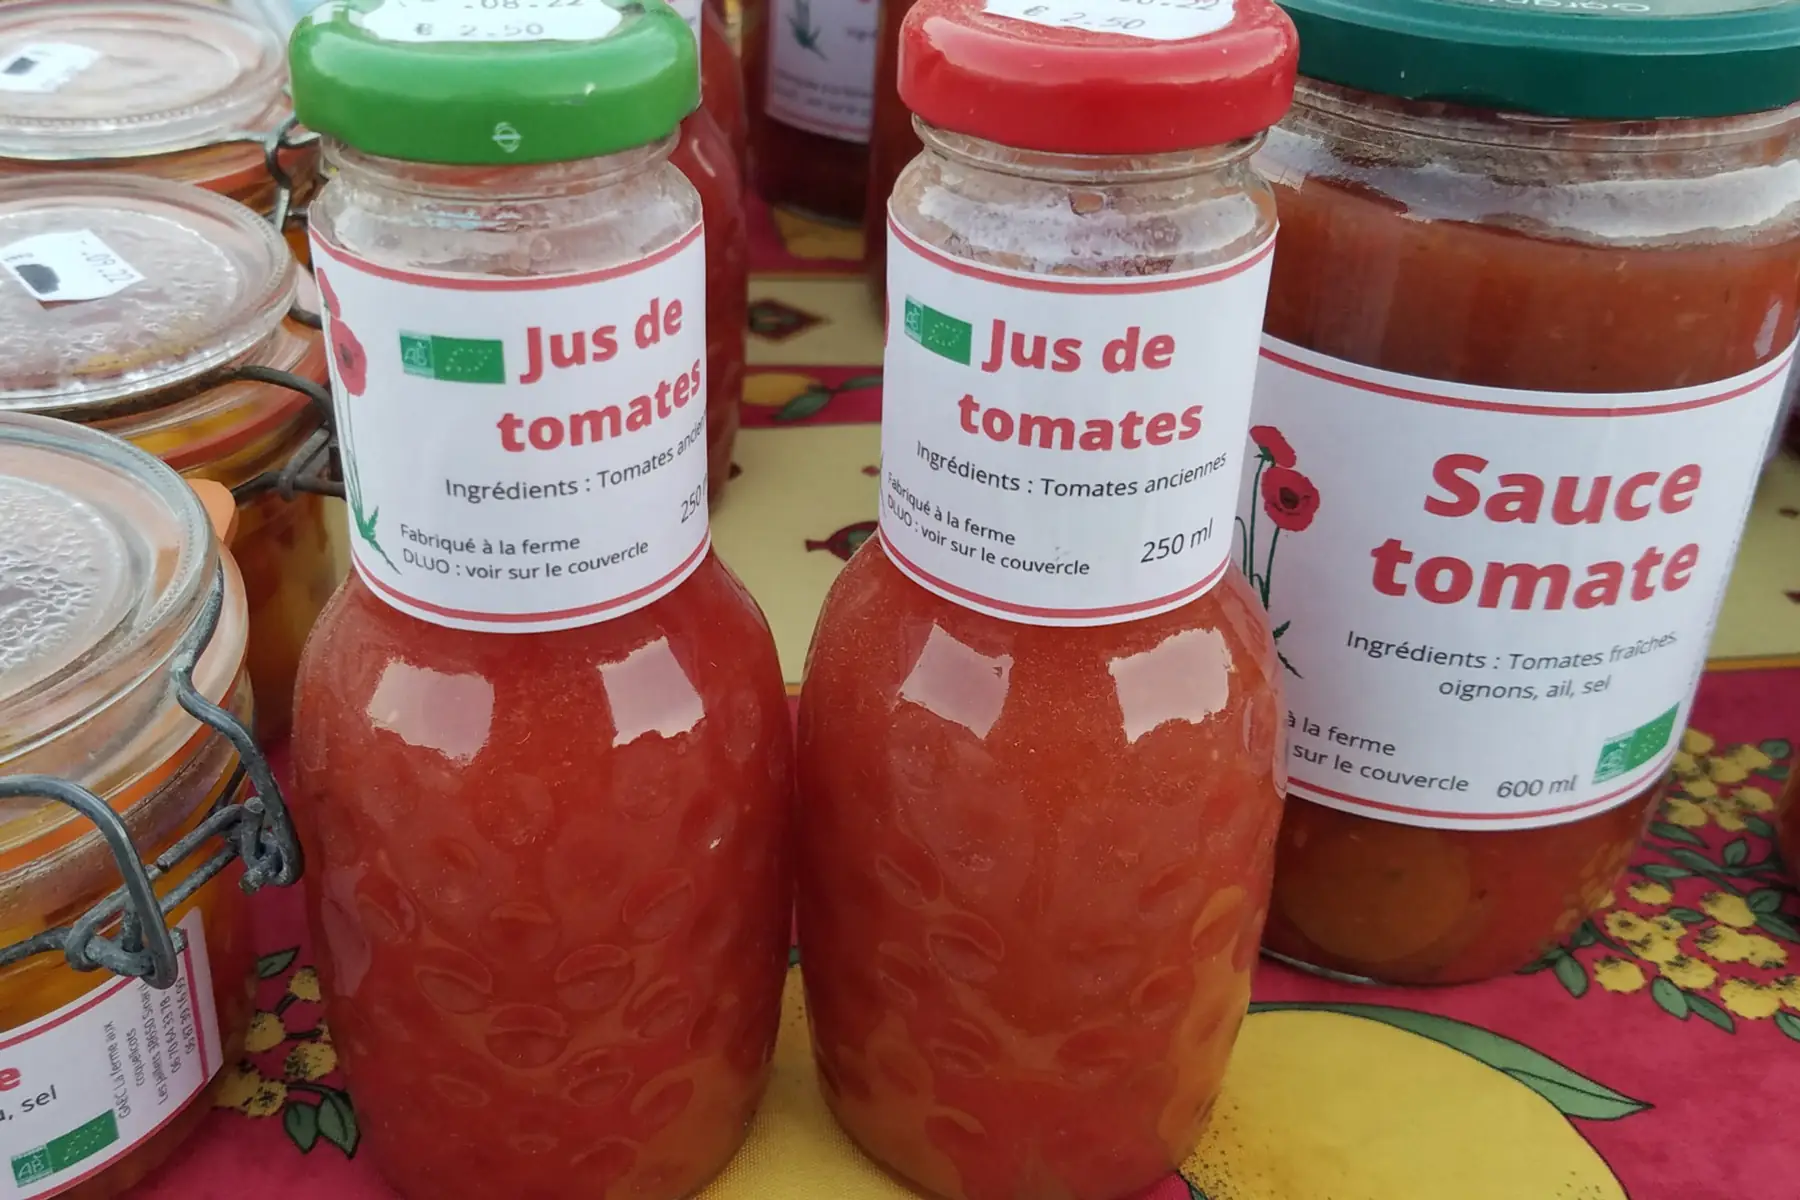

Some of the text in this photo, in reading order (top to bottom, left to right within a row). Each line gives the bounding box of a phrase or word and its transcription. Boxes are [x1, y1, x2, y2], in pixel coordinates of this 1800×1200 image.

[460, 24, 544, 37] 2.50
[1060, 12, 1146, 30] 2.50
[519, 297, 683, 385] Jus de
[981, 318, 1176, 374] Jus de
[496, 357, 702, 453] tomates
[957, 393, 1205, 452] tomates
[445, 477, 578, 504] Ingrédients
[585, 478, 591, 492] :
[597, 448, 674, 490] Tomates
[916, 440, 1228, 498] Ingrédients : Tomates anciennes
[1423, 453, 1702, 526] Sauce
[680, 487, 702, 524] 250
[887, 471, 1016, 546] Fabriqué à la ferme
[399, 523, 581, 556] Fabriqué à la ferme
[402, 539, 650, 581] DLUO : voir sur le couvercle
[886, 494, 1090, 576] DLUO : voir sur le couvercle
[1140, 518, 1214, 564] 250 ml
[1370, 538, 1701, 611] tomate
[1346, 629, 1678, 672] Ingrédients : Tomates fraîches
[1438, 674, 1612, 703] oignons, ail, sel
[1302, 716, 1321, 738] la
[1327, 725, 1397, 757] ferme
[1292, 744, 1470, 794] sur le couvercle
[1496, 774, 1578, 799] 600 ml
[0, 1067, 21, 1092] e
[103, 1020, 132, 1120] GAEC La ferme aux
[125, 1027, 147, 1087] coquelicots
[21, 1084, 57, 1113] sel
